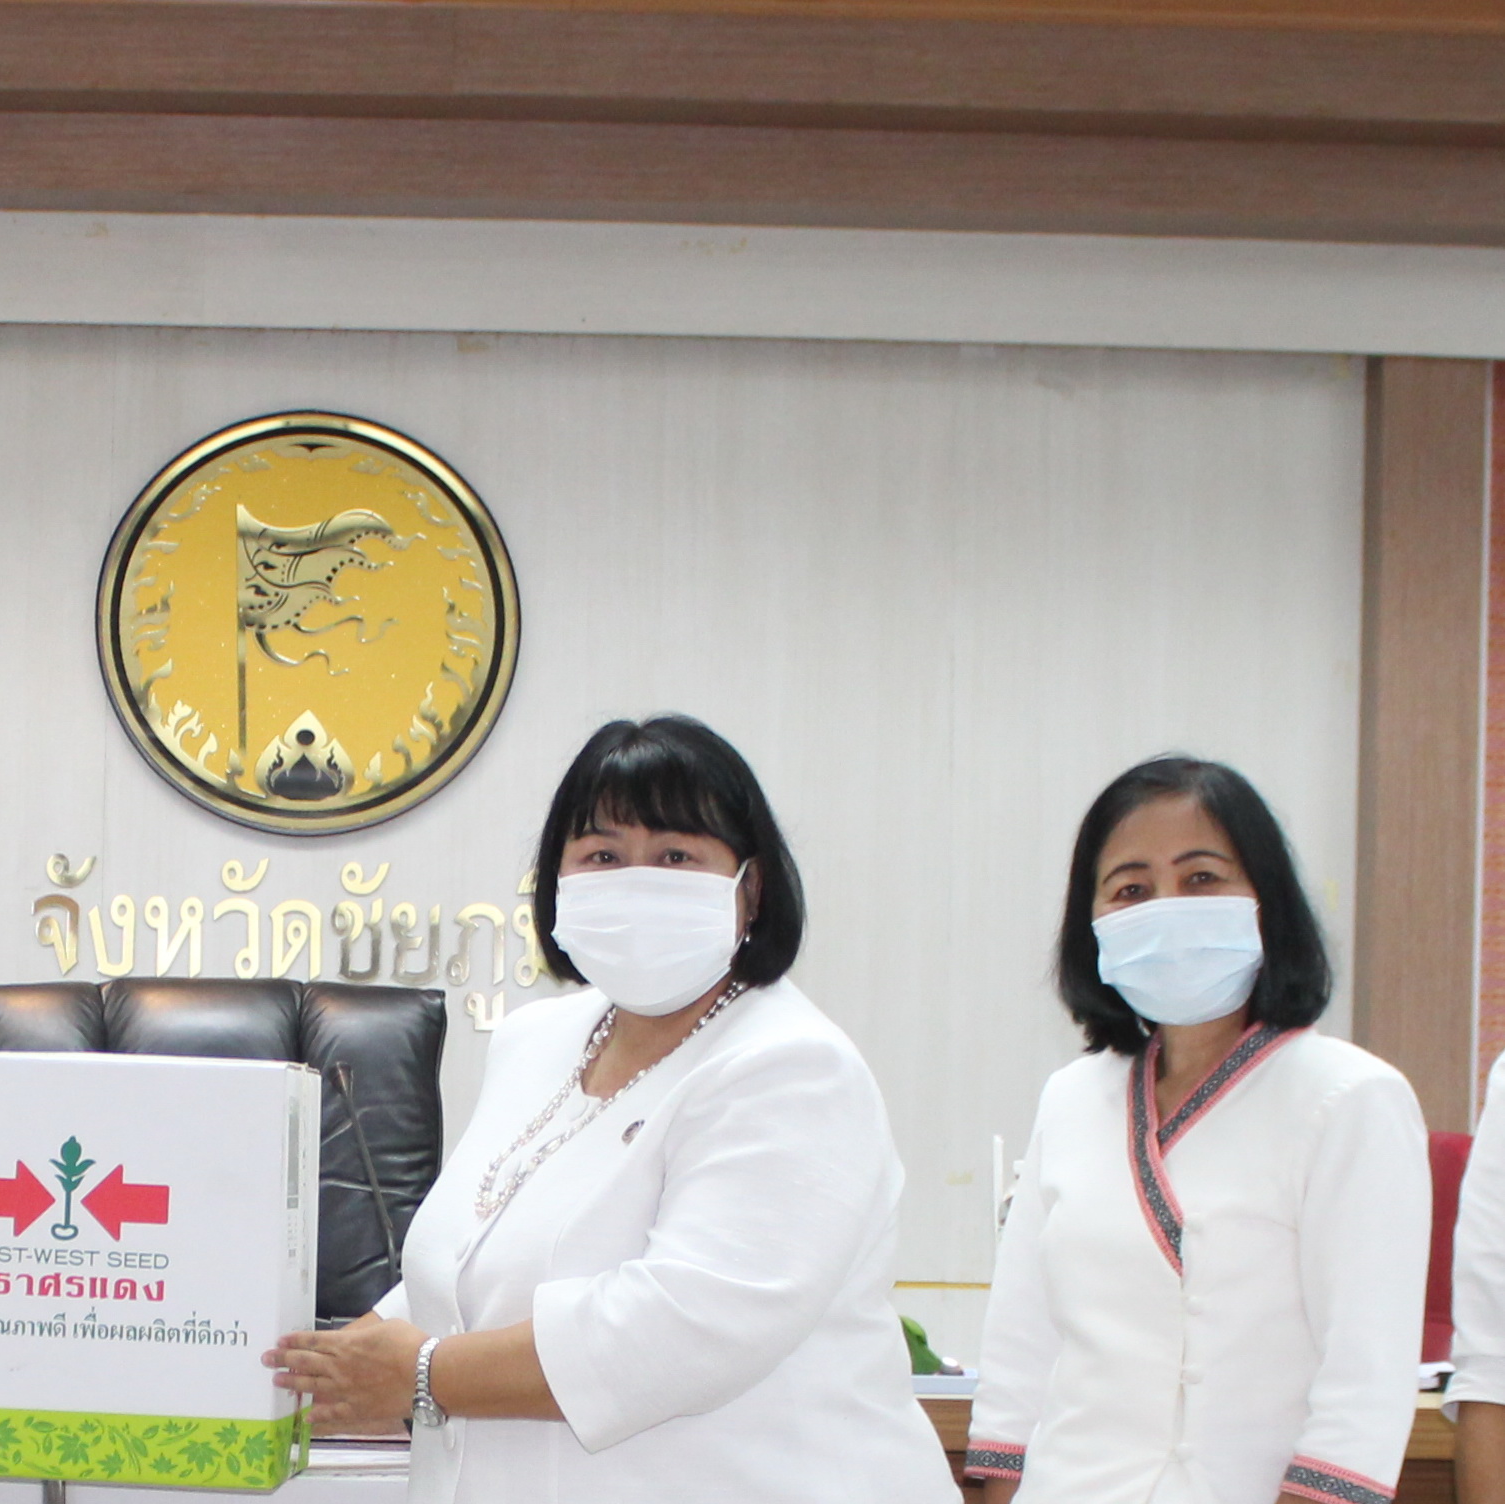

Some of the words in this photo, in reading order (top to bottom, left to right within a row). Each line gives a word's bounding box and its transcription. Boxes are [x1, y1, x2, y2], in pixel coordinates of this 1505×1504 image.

[106, 1251, 170, 1271] SEED
[72, 1307, 248, 1348] เพื่อผลผลิตที่ดีกว่า
